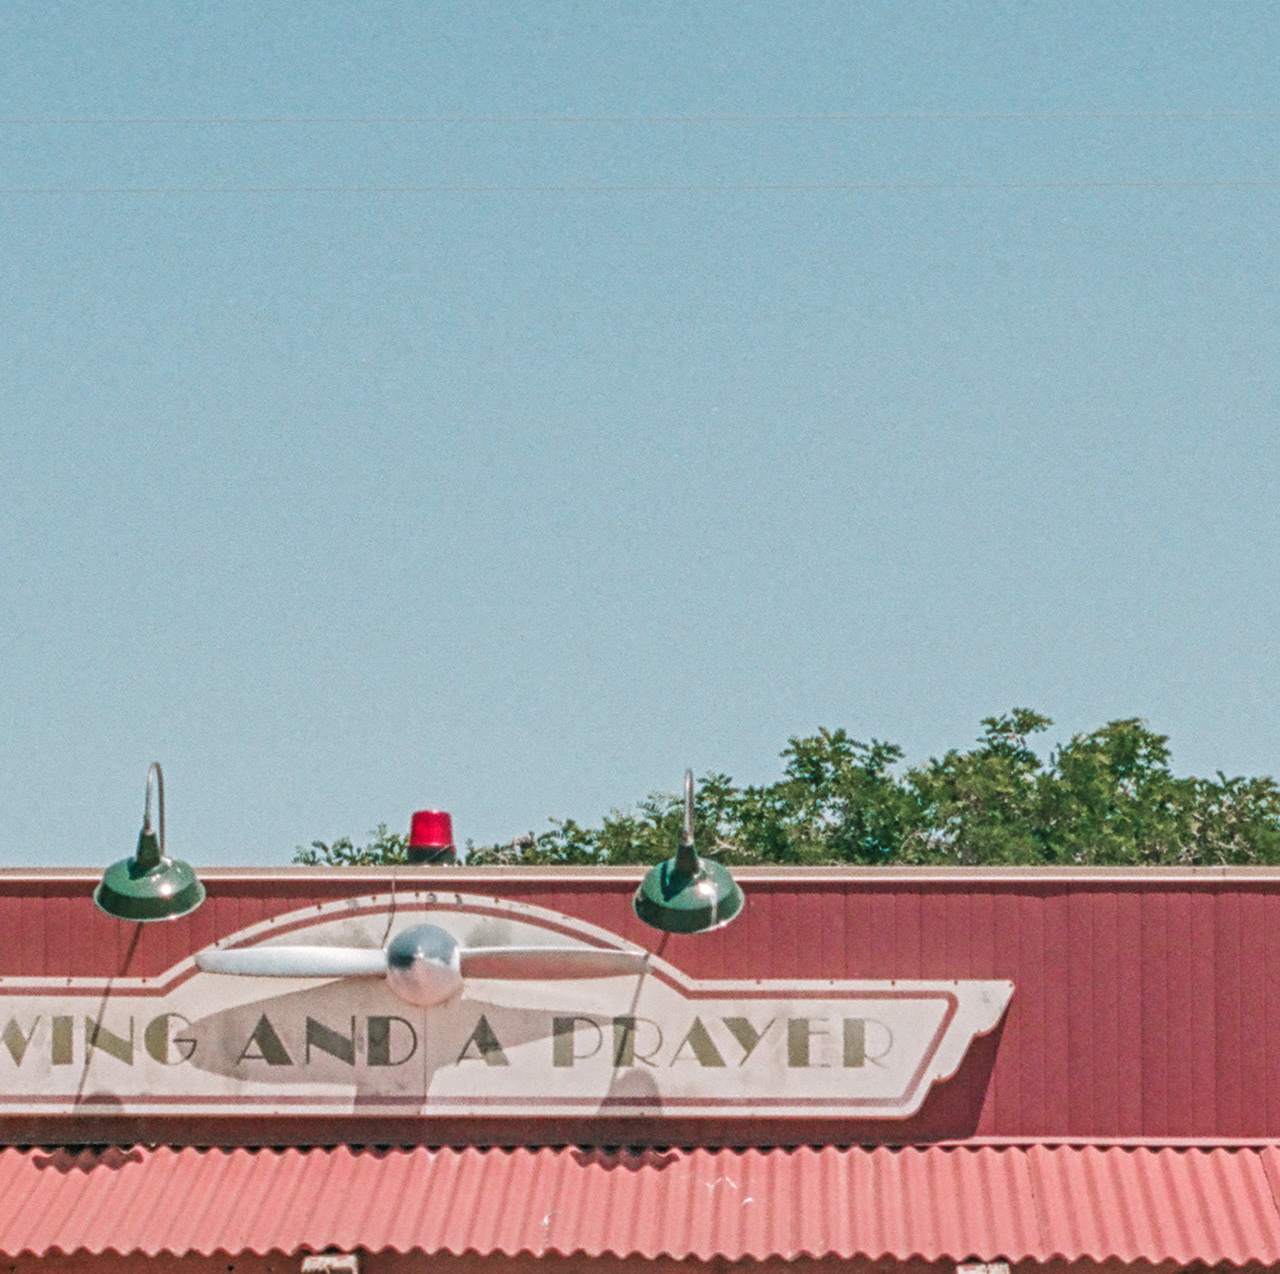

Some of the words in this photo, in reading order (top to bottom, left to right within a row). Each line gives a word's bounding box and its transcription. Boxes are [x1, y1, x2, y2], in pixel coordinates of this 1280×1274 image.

[235, 1013, 418, 1067] AND
[455, 1014, 510, 1067] A
[552, 1015, 894, 1068] PRAYER
